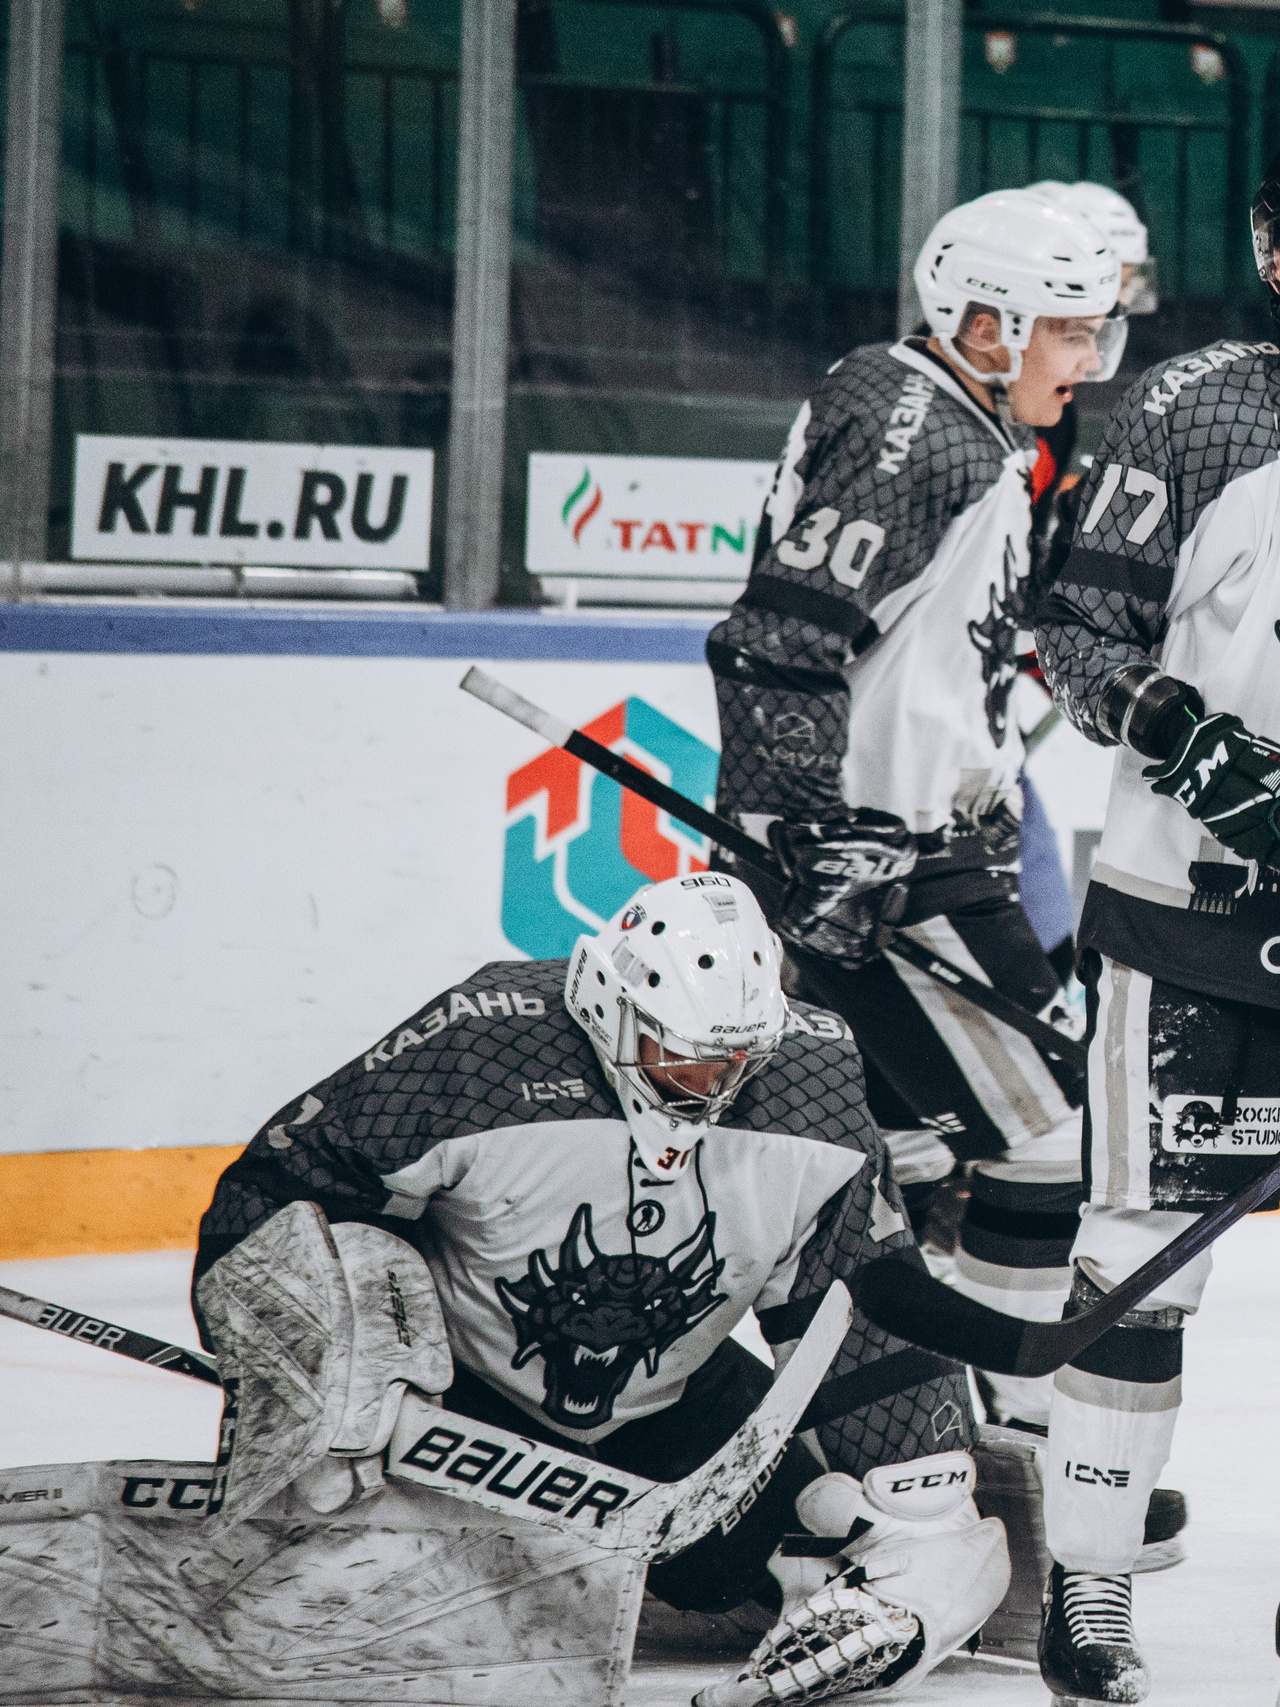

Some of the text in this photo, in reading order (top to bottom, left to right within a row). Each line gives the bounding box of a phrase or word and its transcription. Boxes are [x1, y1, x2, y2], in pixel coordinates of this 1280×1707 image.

[966, 277, 1009, 295] CCM
[98, 461, 409, 544] KHL.RU
[1081, 463, 1168, 545] 17
[611, 519, 760, 555] TATN
[776, 506, 886, 590] 30
[680, 876, 732, 891] 960
[364, 991, 546, 1072] КАЗАНЬ
[120, 1476, 218, 1510] CC
[890, 1470, 968, 1494] CCM
